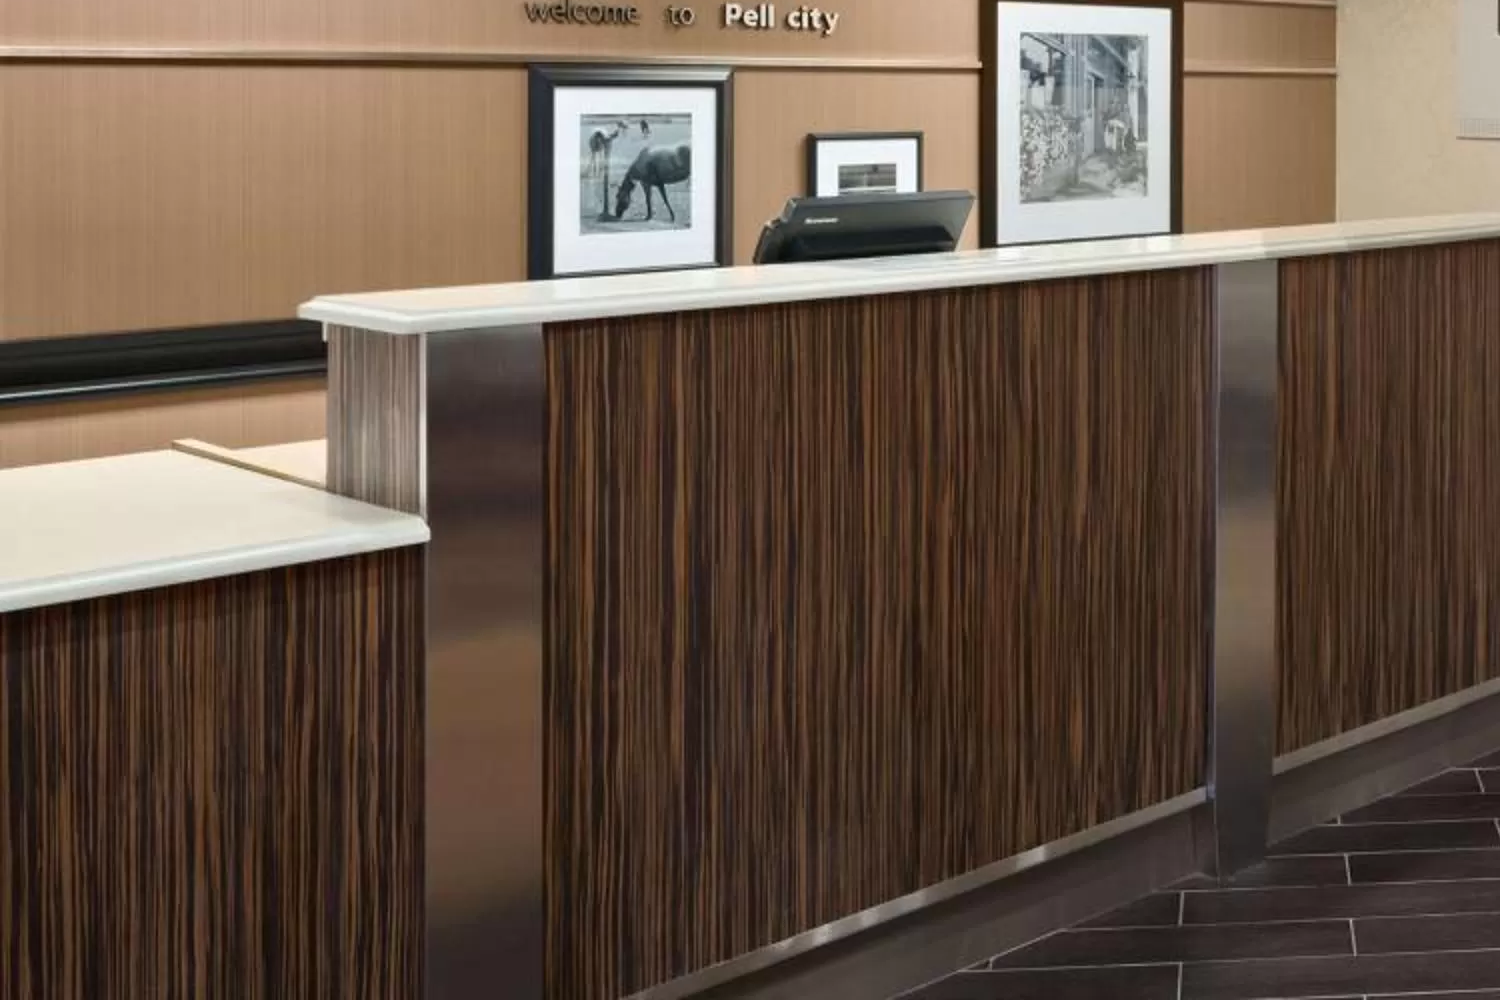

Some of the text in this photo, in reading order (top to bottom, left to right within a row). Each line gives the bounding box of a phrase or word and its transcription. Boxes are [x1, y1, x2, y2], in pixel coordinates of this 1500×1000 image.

[665, 3, 696, 27] to
[722, 1, 776, 29] Pell
[784, 3, 840, 37] city
